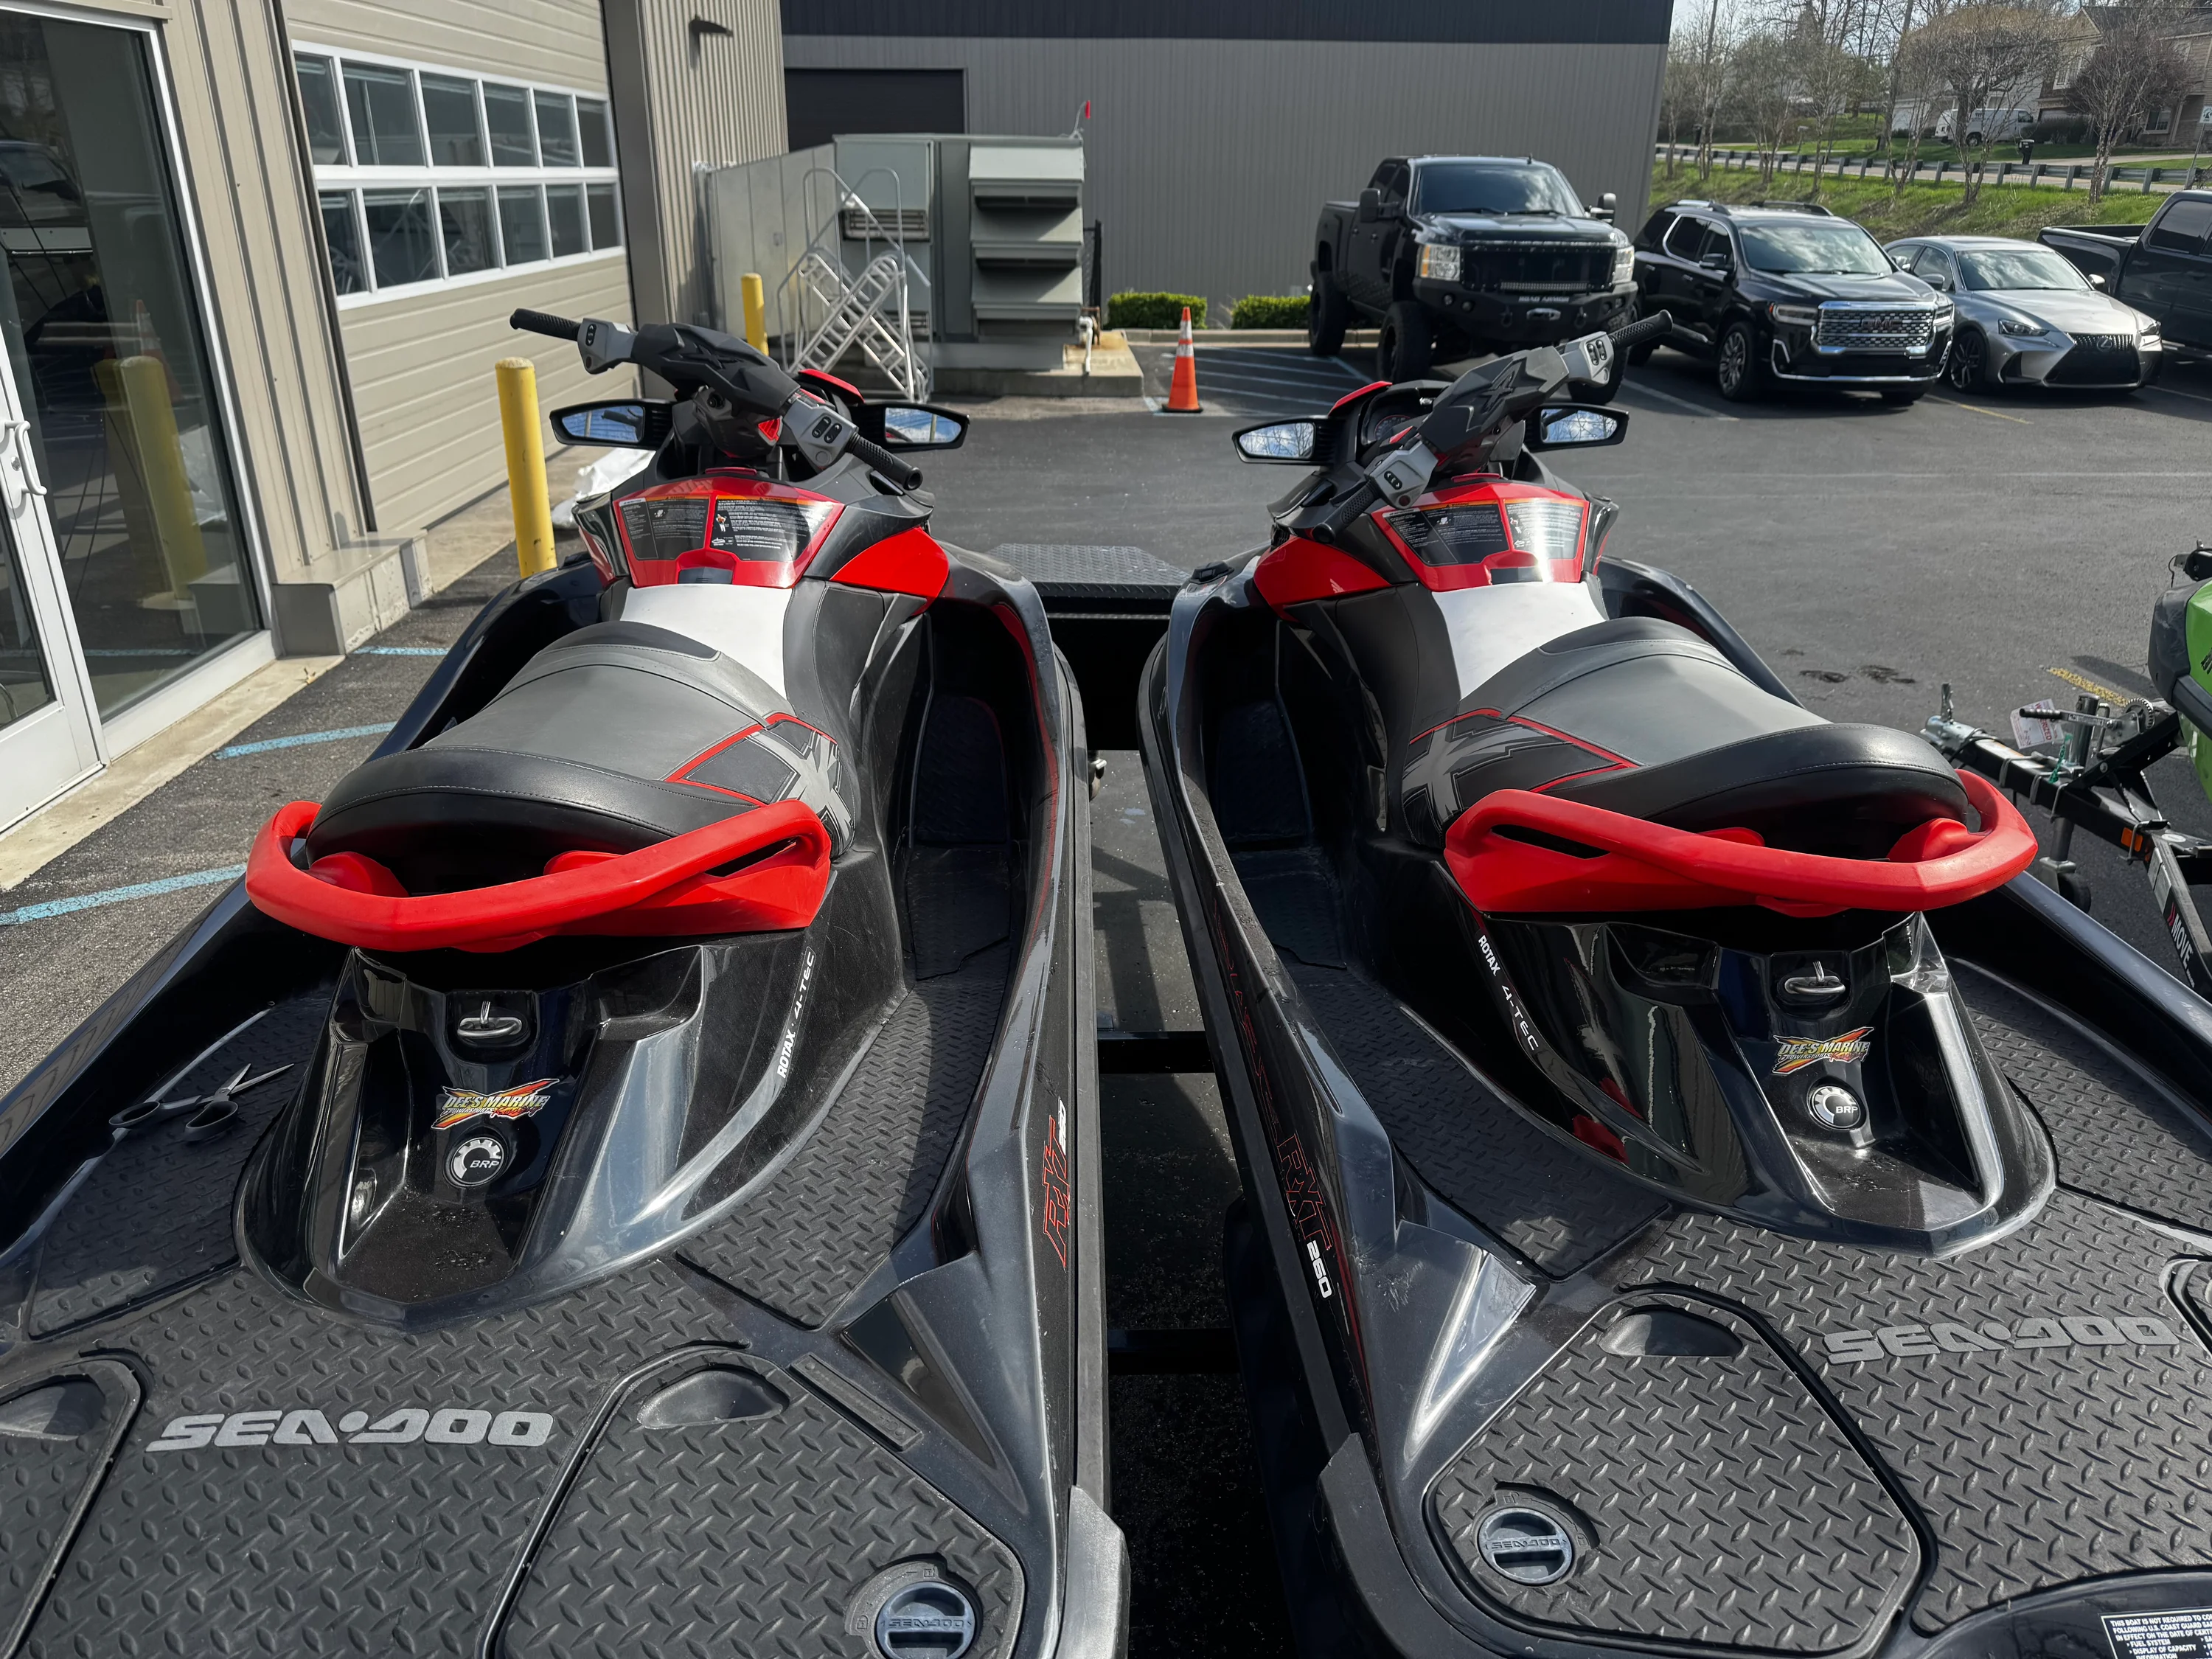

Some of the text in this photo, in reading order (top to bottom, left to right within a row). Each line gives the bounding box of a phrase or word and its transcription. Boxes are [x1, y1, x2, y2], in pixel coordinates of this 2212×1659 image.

[2171, 913, 2194, 970] MOVE
[1478, 934, 1539, 1051] ROTAX 4-TEC
[776, 951, 815, 1079] ROTAX 4-TEC
[1778, 1042, 1868, 1054] DEE'S MARINE
[443, 1095, 548, 1108] DEE'S MARINE
[1835, 1105, 1858, 1114] BRP
[470, 1160, 500, 1169] BRP
[1306, 1239, 1332, 1298] 260
[2162, 1615, 2193, 1623] REQUIRED
[2112, 1625, 2149, 1634] FOLLOWING
[2160, 1623, 2180, 1631] COAST
[2180, 1621, 2202, 1630] GUARD
[2123, 1632, 2146, 1641] EFFECT
[2168, 1630, 2185, 1638] DATE
[2146, 1638, 2171, 1646] SYSTEM
[2132, 1646, 2157, 1655] DISPLAY
[2167, 1644, 2197, 1652] CAPACITY
